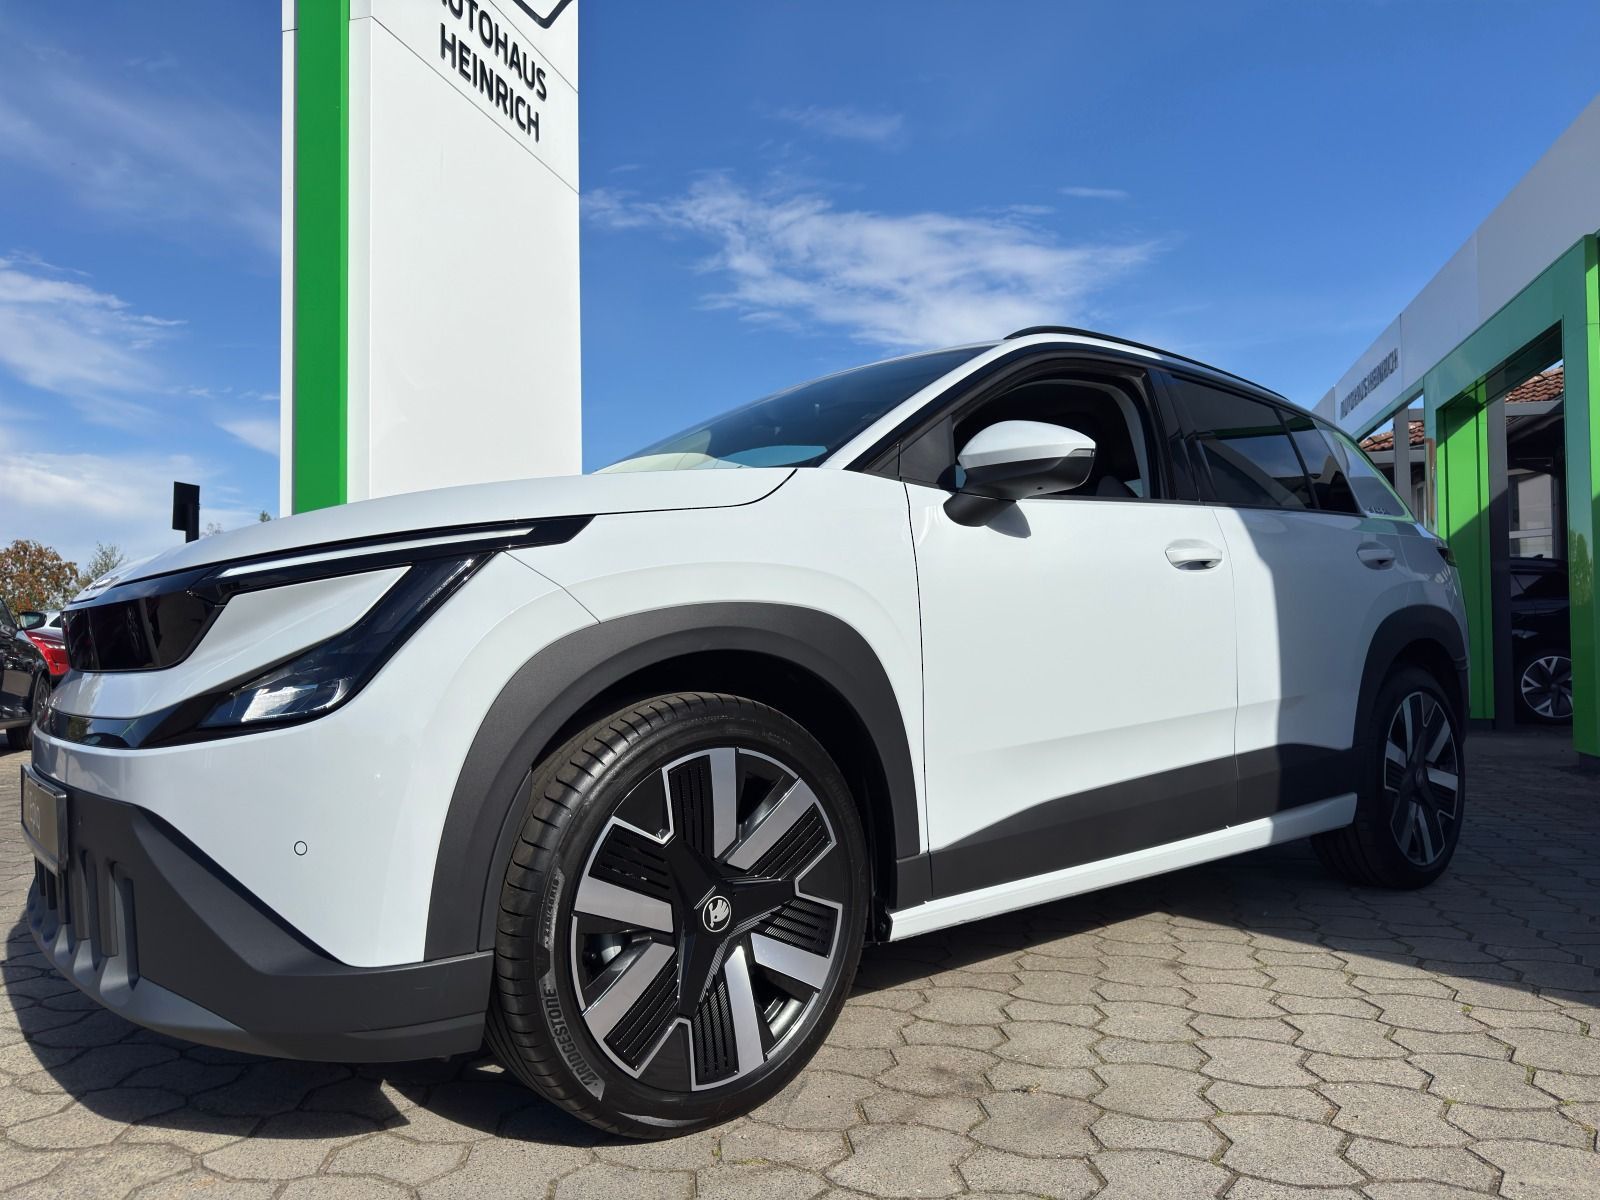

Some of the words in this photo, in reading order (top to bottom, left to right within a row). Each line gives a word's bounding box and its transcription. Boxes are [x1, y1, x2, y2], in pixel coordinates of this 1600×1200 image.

[440, 22, 539, 144] HEINRICH
[441, 0, 547, 102] UTOHAUS
[543, 983, 596, 1087] BRIDGESTONE
